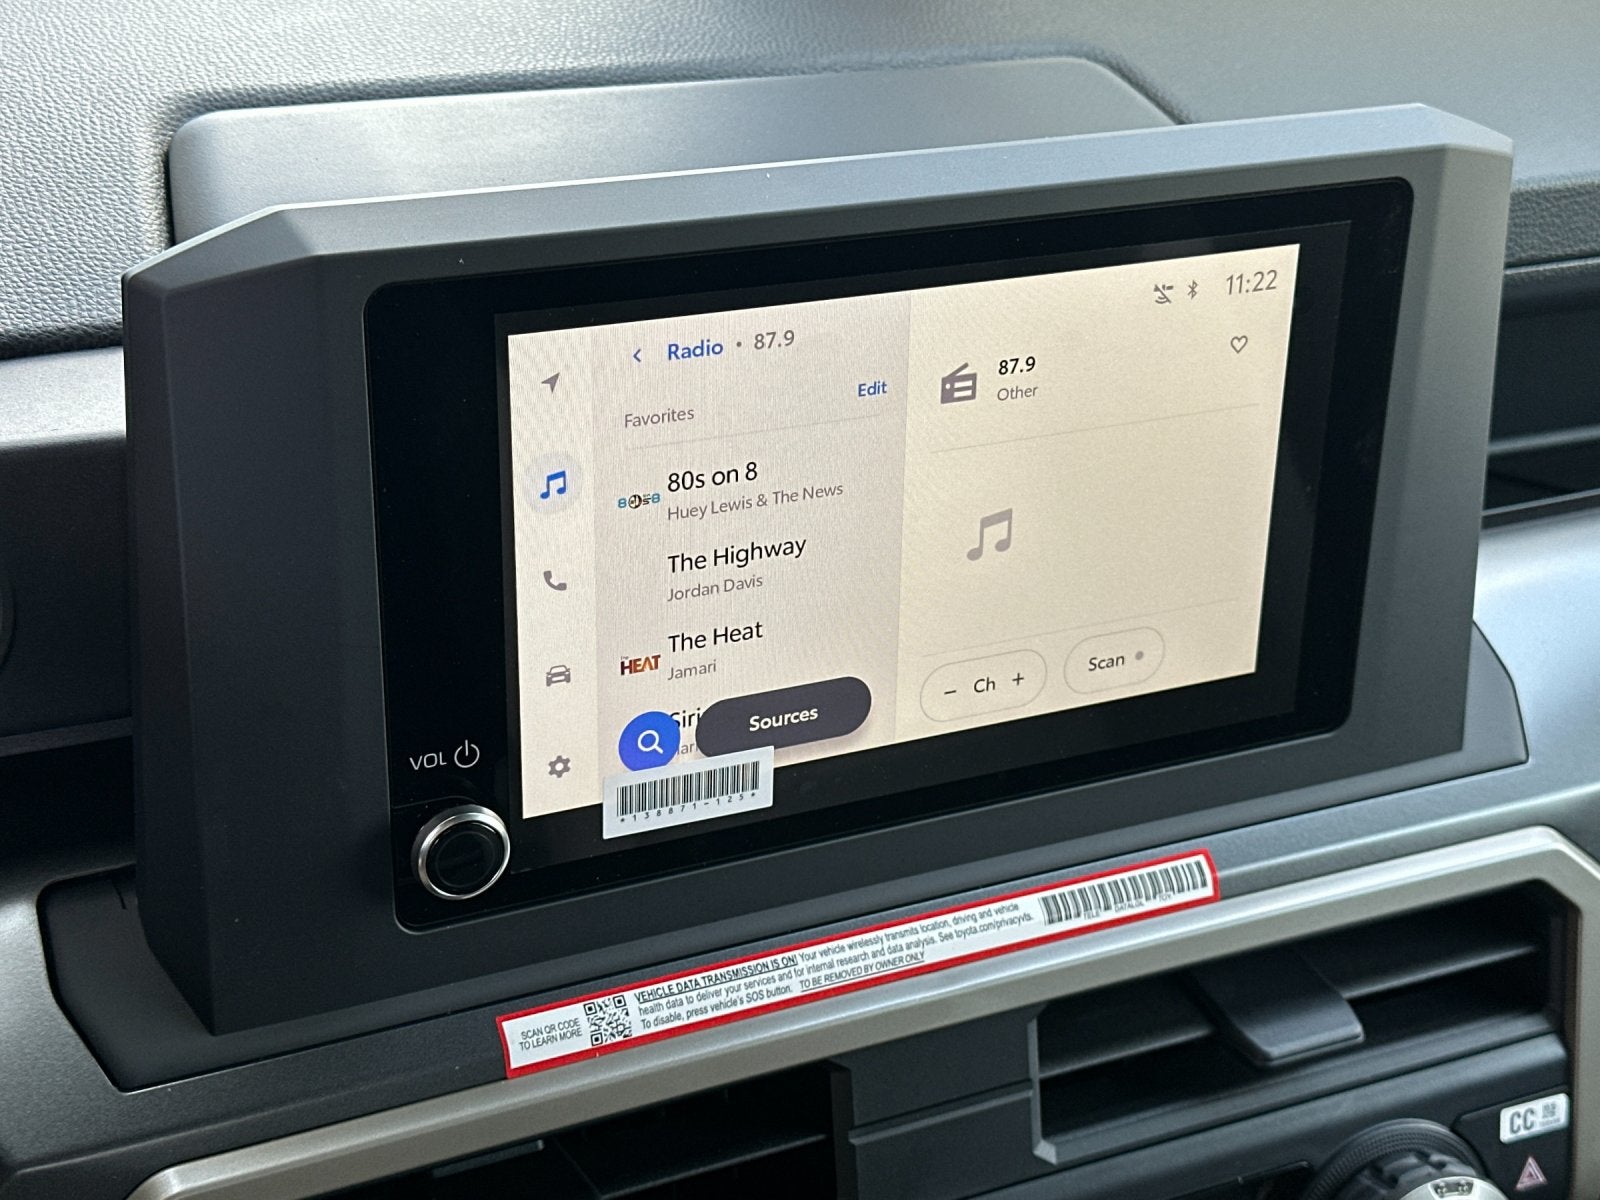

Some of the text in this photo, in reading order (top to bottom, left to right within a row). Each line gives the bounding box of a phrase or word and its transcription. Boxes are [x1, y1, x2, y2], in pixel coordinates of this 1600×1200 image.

[1225, 269, 1279, 296] 11:22
[667, 329, 795, 361] Radio 87.9
[998, 355, 1036, 376] 87.9
[857, 380, 888, 398] Edit
[996, 384, 1039, 402] Other
[623, 407, 695, 428] Favorites
[667, 461, 758, 492] 80s on 8
[667, 482, 844, 521] Huey Lewis & The News
[667, 538, 807, 573] The Highway
[667, 574, 764, 602] Jordan Davis
[668, 621, 764, 653] The Heat
[620, 655, 662, 676] HEAT
[667, 659, 717, 681] Jamari
[1088, 654, 1125, 672] Scan
[973, 676, 996, 694] Ch
[748, 705, 819, 733] Sources
[409, 751, 448, 771] VOL
[634, 984, 677, 1002] VEHICLE
[676, 979, 700, 993] DATA
[702, 960, 769, 986] TRANSMISSION
[771, 958, 781, 969] IS
[799, 952, 817, 963] Your
[820, 944, 846, 957] vehicle
[847, 935, 884, 952] wirelessly
[884, 927, 919, 940] transmits
[920, 920, 953, 934] location,
[952, 912, 978, 927] driving
[978, 909, 993, 920] and
[994, 902, 1019, 915] vehicle
[639, 1002, 665, 1017] health
[665, 998, 684, 1010] data
[685, 994, 695, 1005] to
[696, 988, 722, 1003] deliver
[724, 982, 743, 998] your
[743, 974, 780, 988] services
[778, 969, 793, 982] and
[793, 966, 806, 979] for
[806, 959, 835, 975] internal
[836, 951, 870, 968] research
[871, 946, 886, 958] and
[886, 942, 904, 955] data
[905, 935, 938, 952] analysis.
[938, 931, 954, 943] See
[799, 951, 925, 990] TO BE REMOVED BY OWNER ONLY
[641, 984, 793, 1030] To disable, press vehicle's SOS button.
[519, 1027, 582, 1051] TO LEARN MORE
[521, 1017, 581, 1040] SCAN QR CODE
[1509, 1107, 1535, 1135] CC
